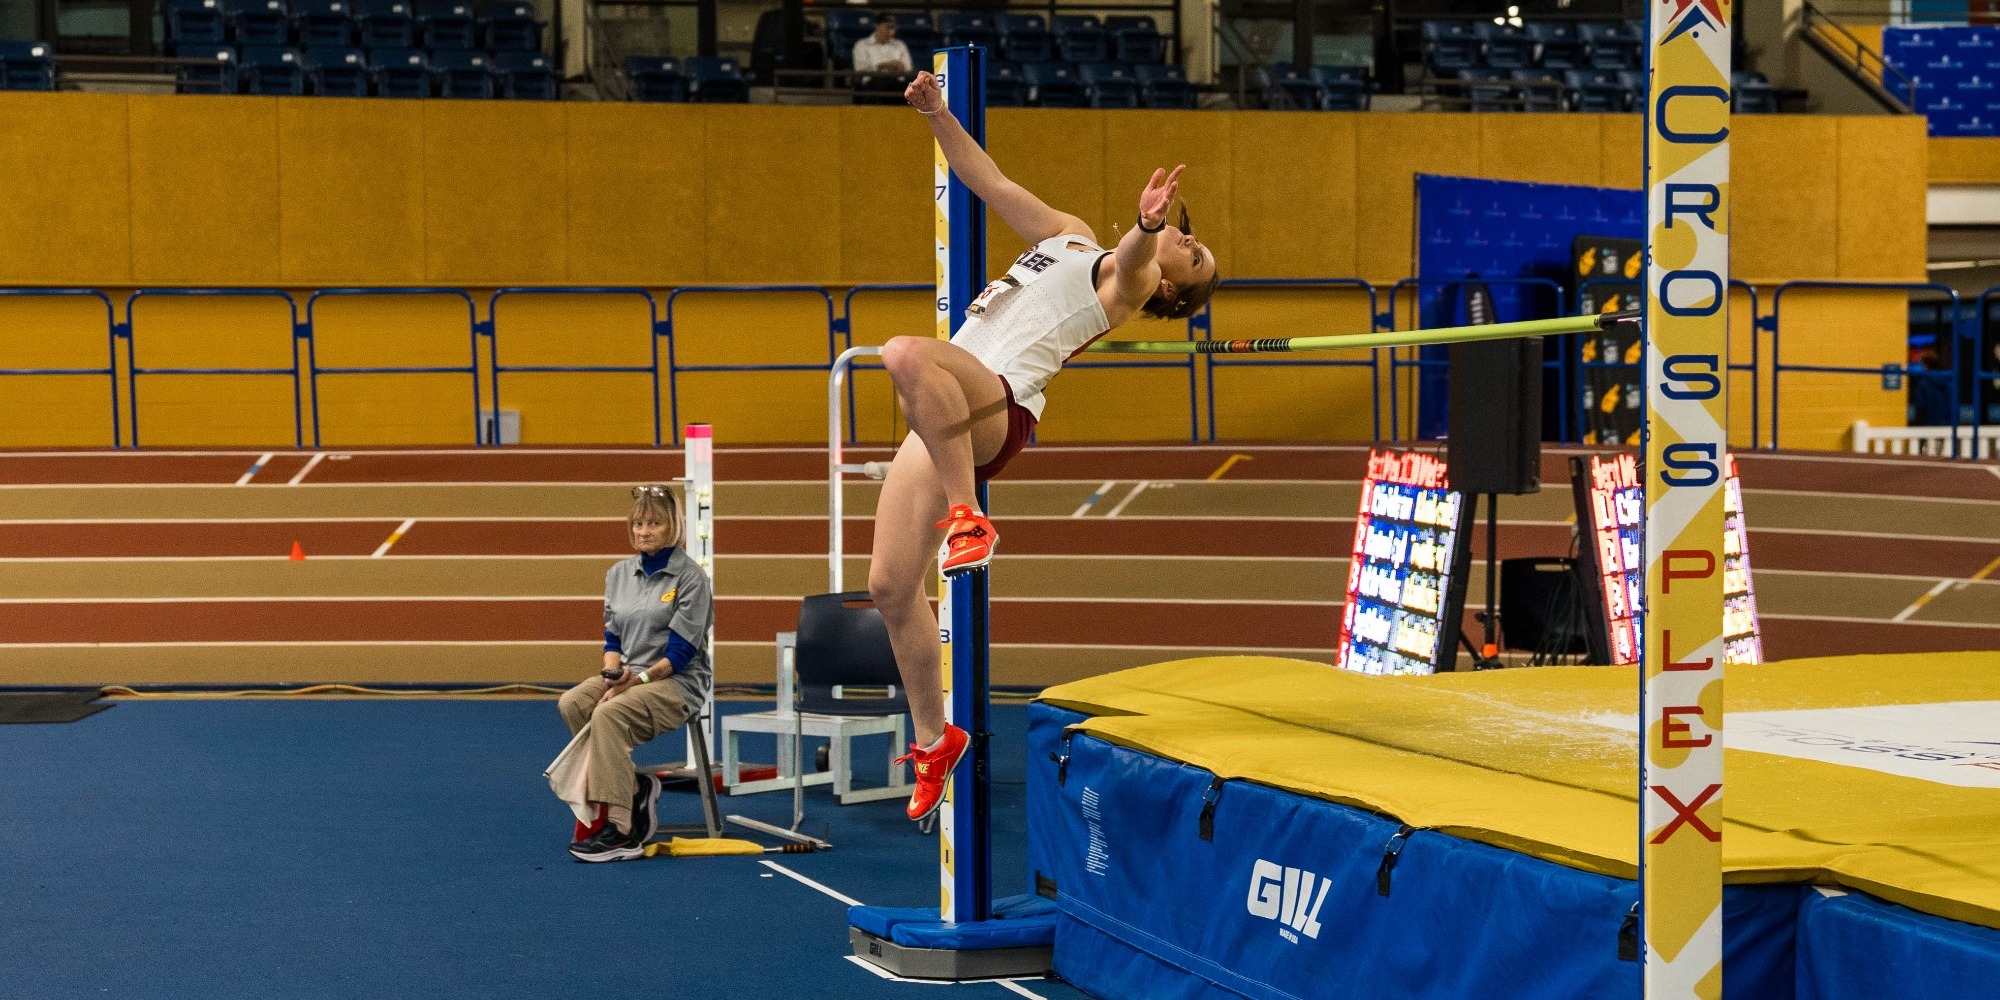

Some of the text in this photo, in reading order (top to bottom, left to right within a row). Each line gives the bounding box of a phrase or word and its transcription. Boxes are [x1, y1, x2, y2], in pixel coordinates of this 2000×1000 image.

[935, 185, 947, 201] 7
[937, 296, 949, 312] 6
[945, 849, 950, 864] 1
[1247, 858, 1333, 940] GILL
